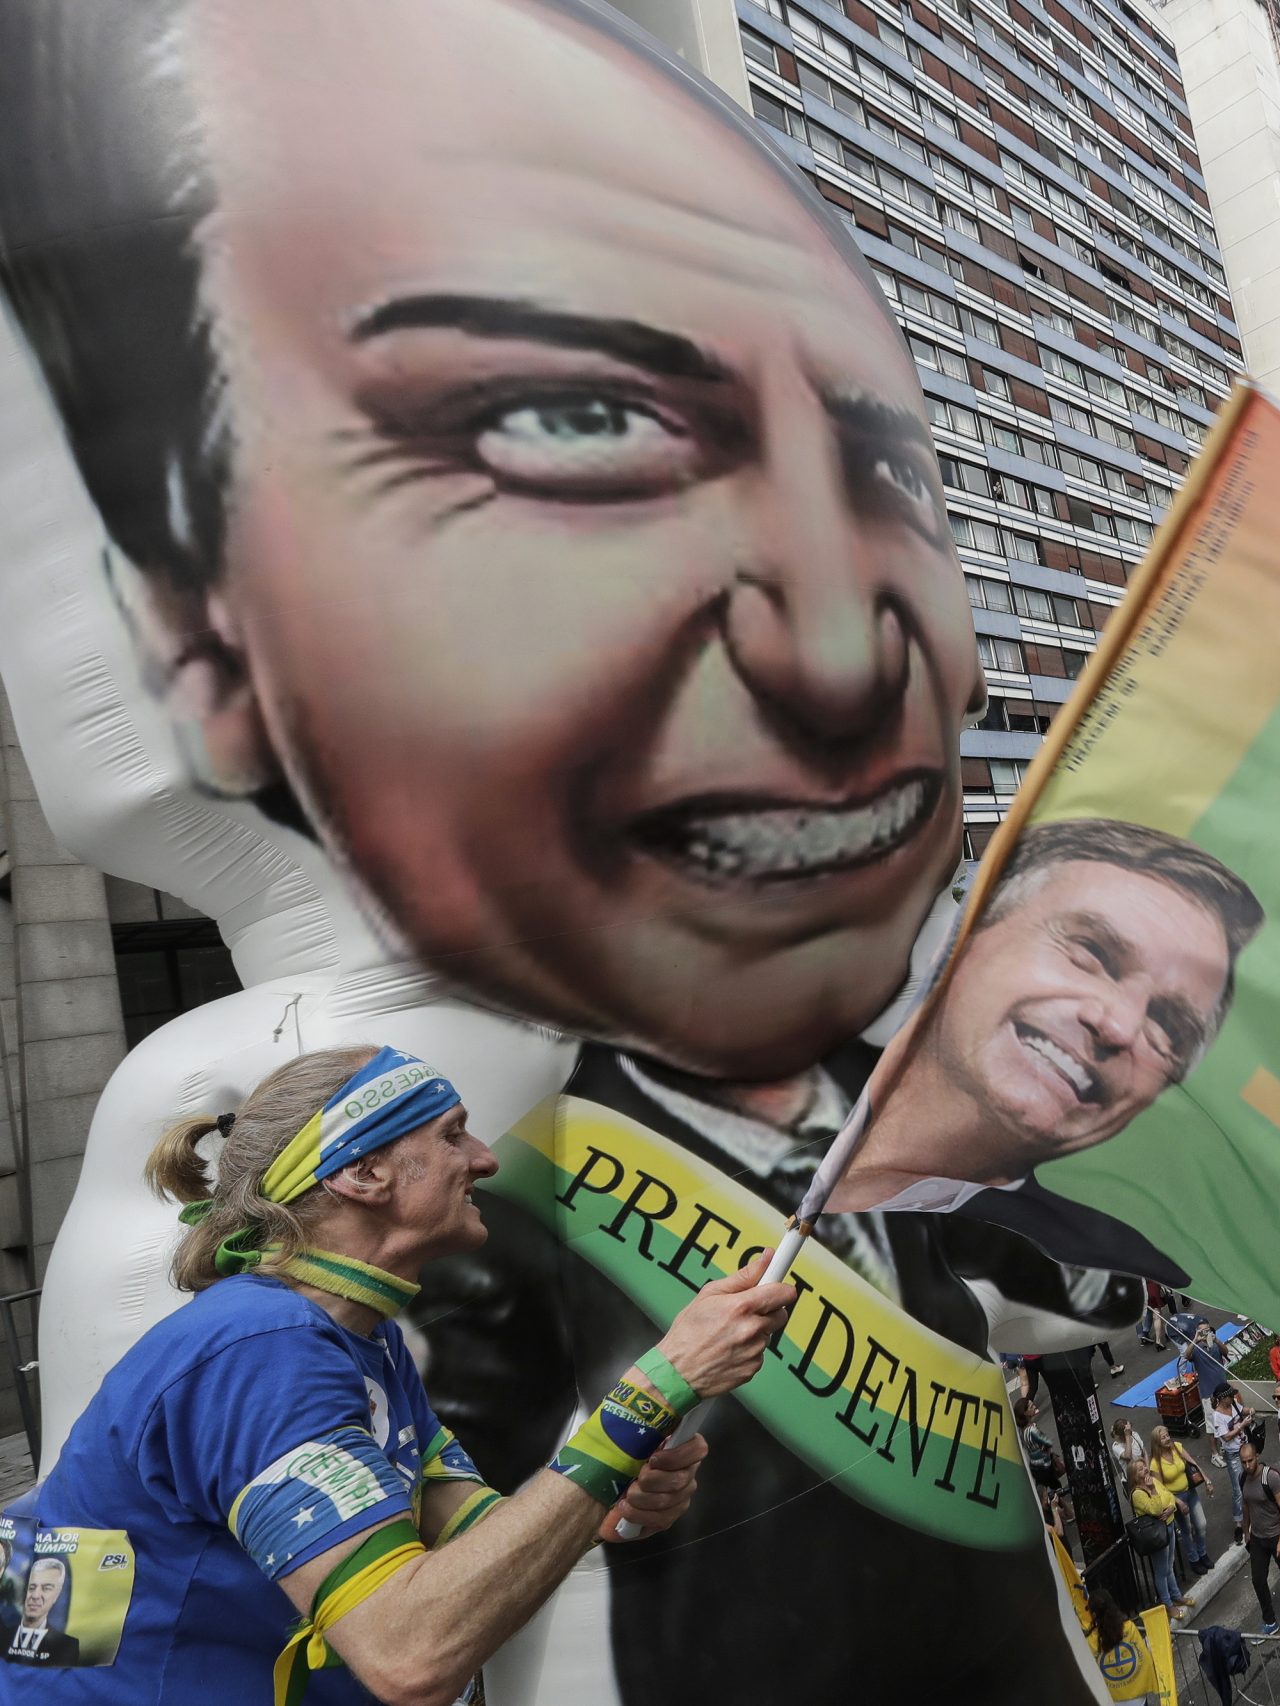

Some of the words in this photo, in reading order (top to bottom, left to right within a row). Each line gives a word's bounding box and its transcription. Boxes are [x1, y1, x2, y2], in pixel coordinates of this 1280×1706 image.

[36, 1532, 80, 1543] MAJOR
[102, 1554, 128, 1566] PSL
[8, 1649, 36, 1659] ENADOR
